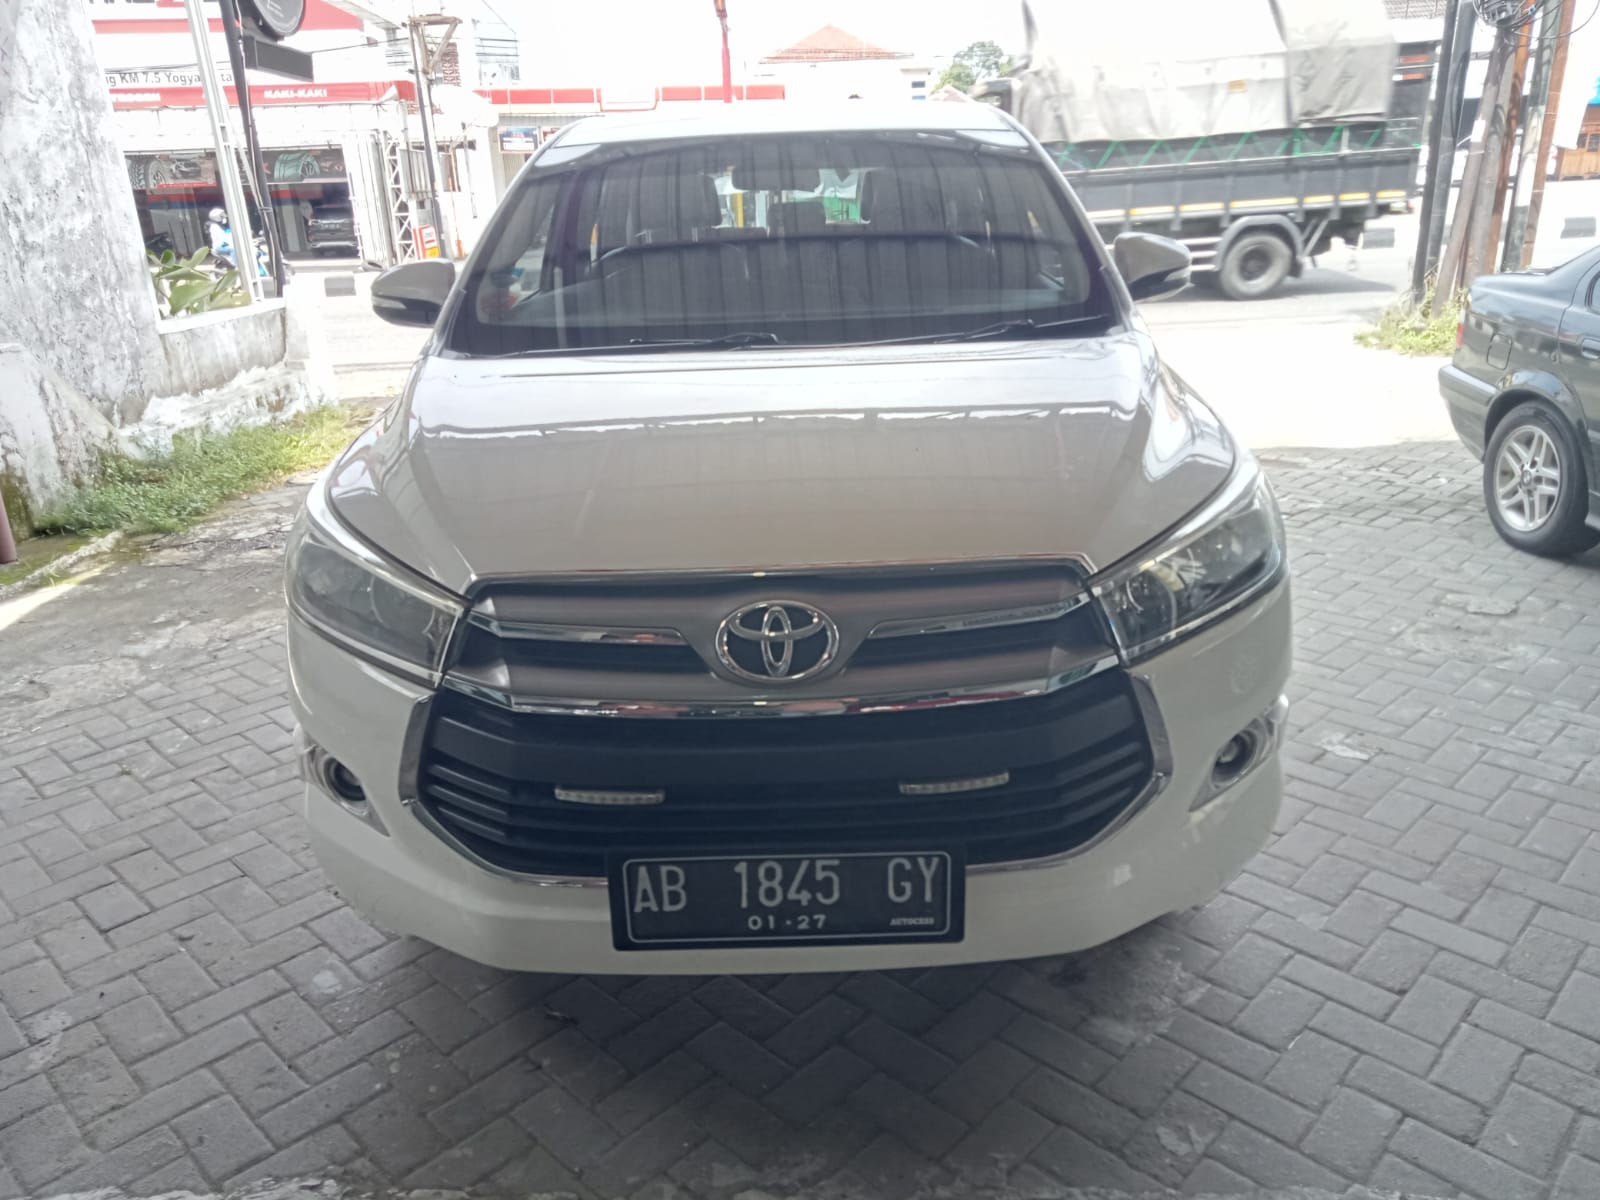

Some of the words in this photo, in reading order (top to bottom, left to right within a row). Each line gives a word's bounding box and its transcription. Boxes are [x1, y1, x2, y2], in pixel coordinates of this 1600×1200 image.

[119, 72, 139, 83] KM
[142, 72, 161, 83] 7.5
[165, 70, 232, 86] Yogyata
[264, 89, 328, 99] KAKI-KAKI
[633, 865, 687, 912] AB
[734, 859, 840, 907] 1845
[888, 857, 940, 903] GY
